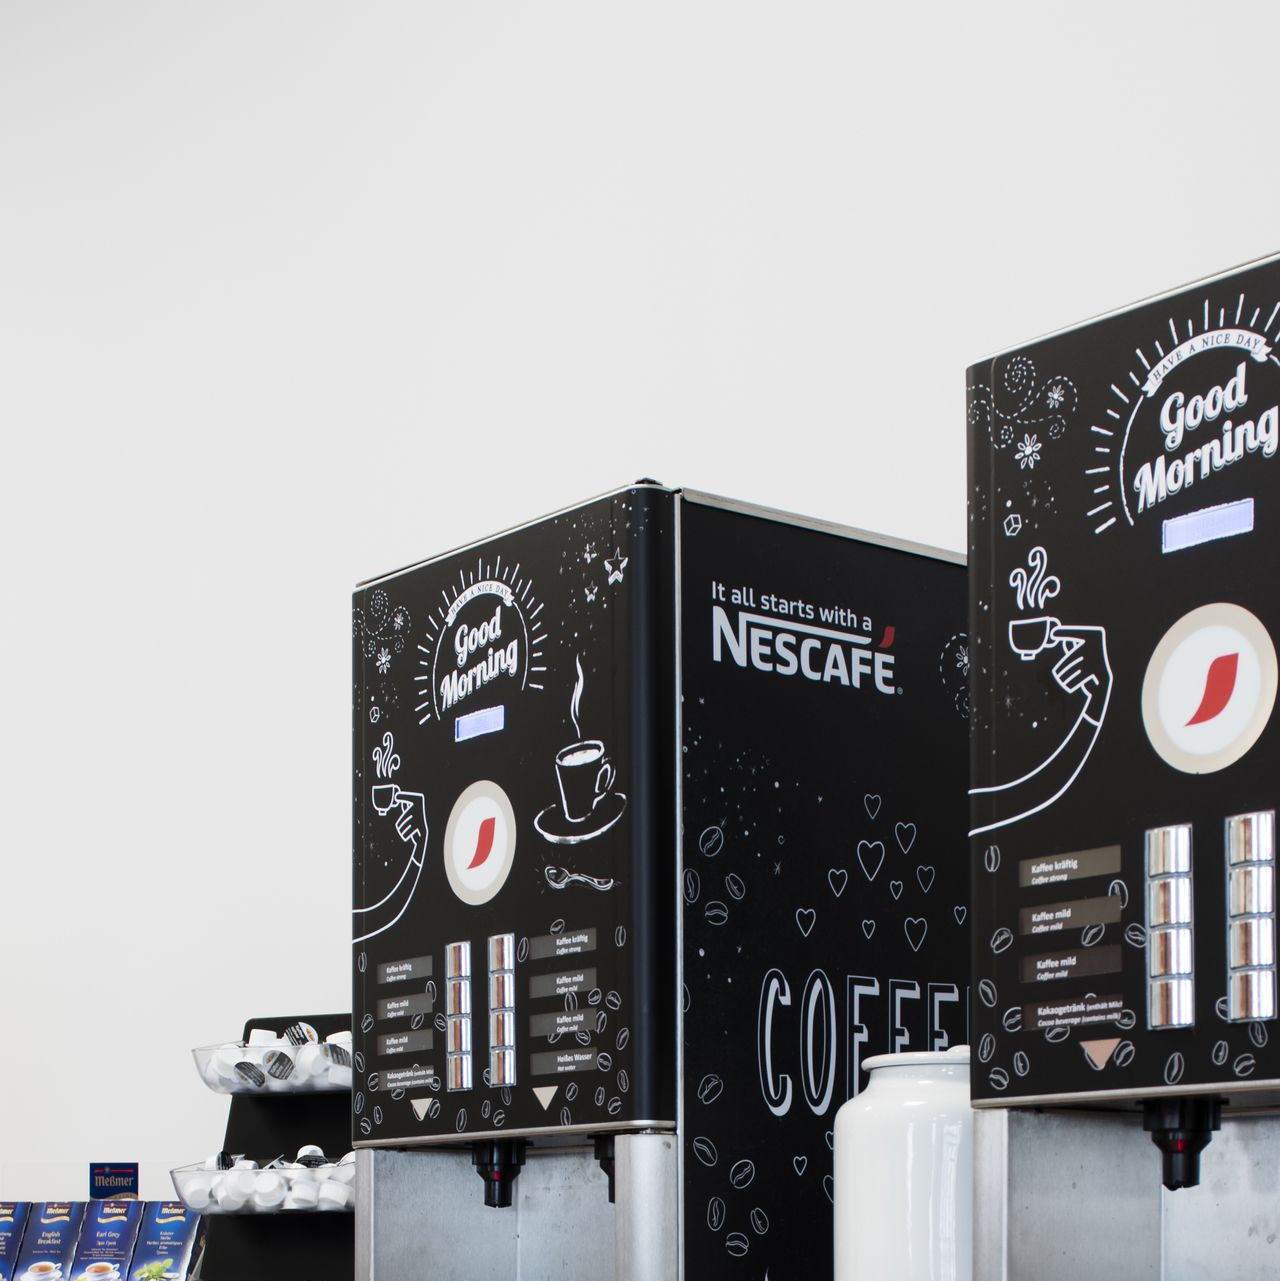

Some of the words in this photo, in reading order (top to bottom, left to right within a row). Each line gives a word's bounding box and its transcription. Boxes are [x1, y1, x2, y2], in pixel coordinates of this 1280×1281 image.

[1152, 351, 1183, 381] HAVE
[1189, 344, 1196, 353] A
[1202, 333, 1231, 348] NICE
[1236, 333, 1261, 349] DAY
[1160, 361, 1248, 452] Good
[1133, 405, 1279, 514] Morning
[478, 583, 493, 593] NICE
[495, 583, 509, 597] DAY
[712, 581, 726, 601] It
[731, 586, 756, 608] all
[760, 593, 815, 619] starts
[819, 606, 857, 629] with
[862, 616, 872, 631] a
[454, 605, 502, 668] Good
[440, 638, 518, 712] Morning
[1031, 863, 1054, 874] Kaffee
[1054, 859, 1078, 870] kräftig
[1032, 911, 1054, 922] Kaffee
[1055, 908, 1071, 919] mild
[1037, 958, 1059, 969] Kaffee
[1060, 956, 1077, 966] mild
[95, 1175, 134, 1187] Meßmer
